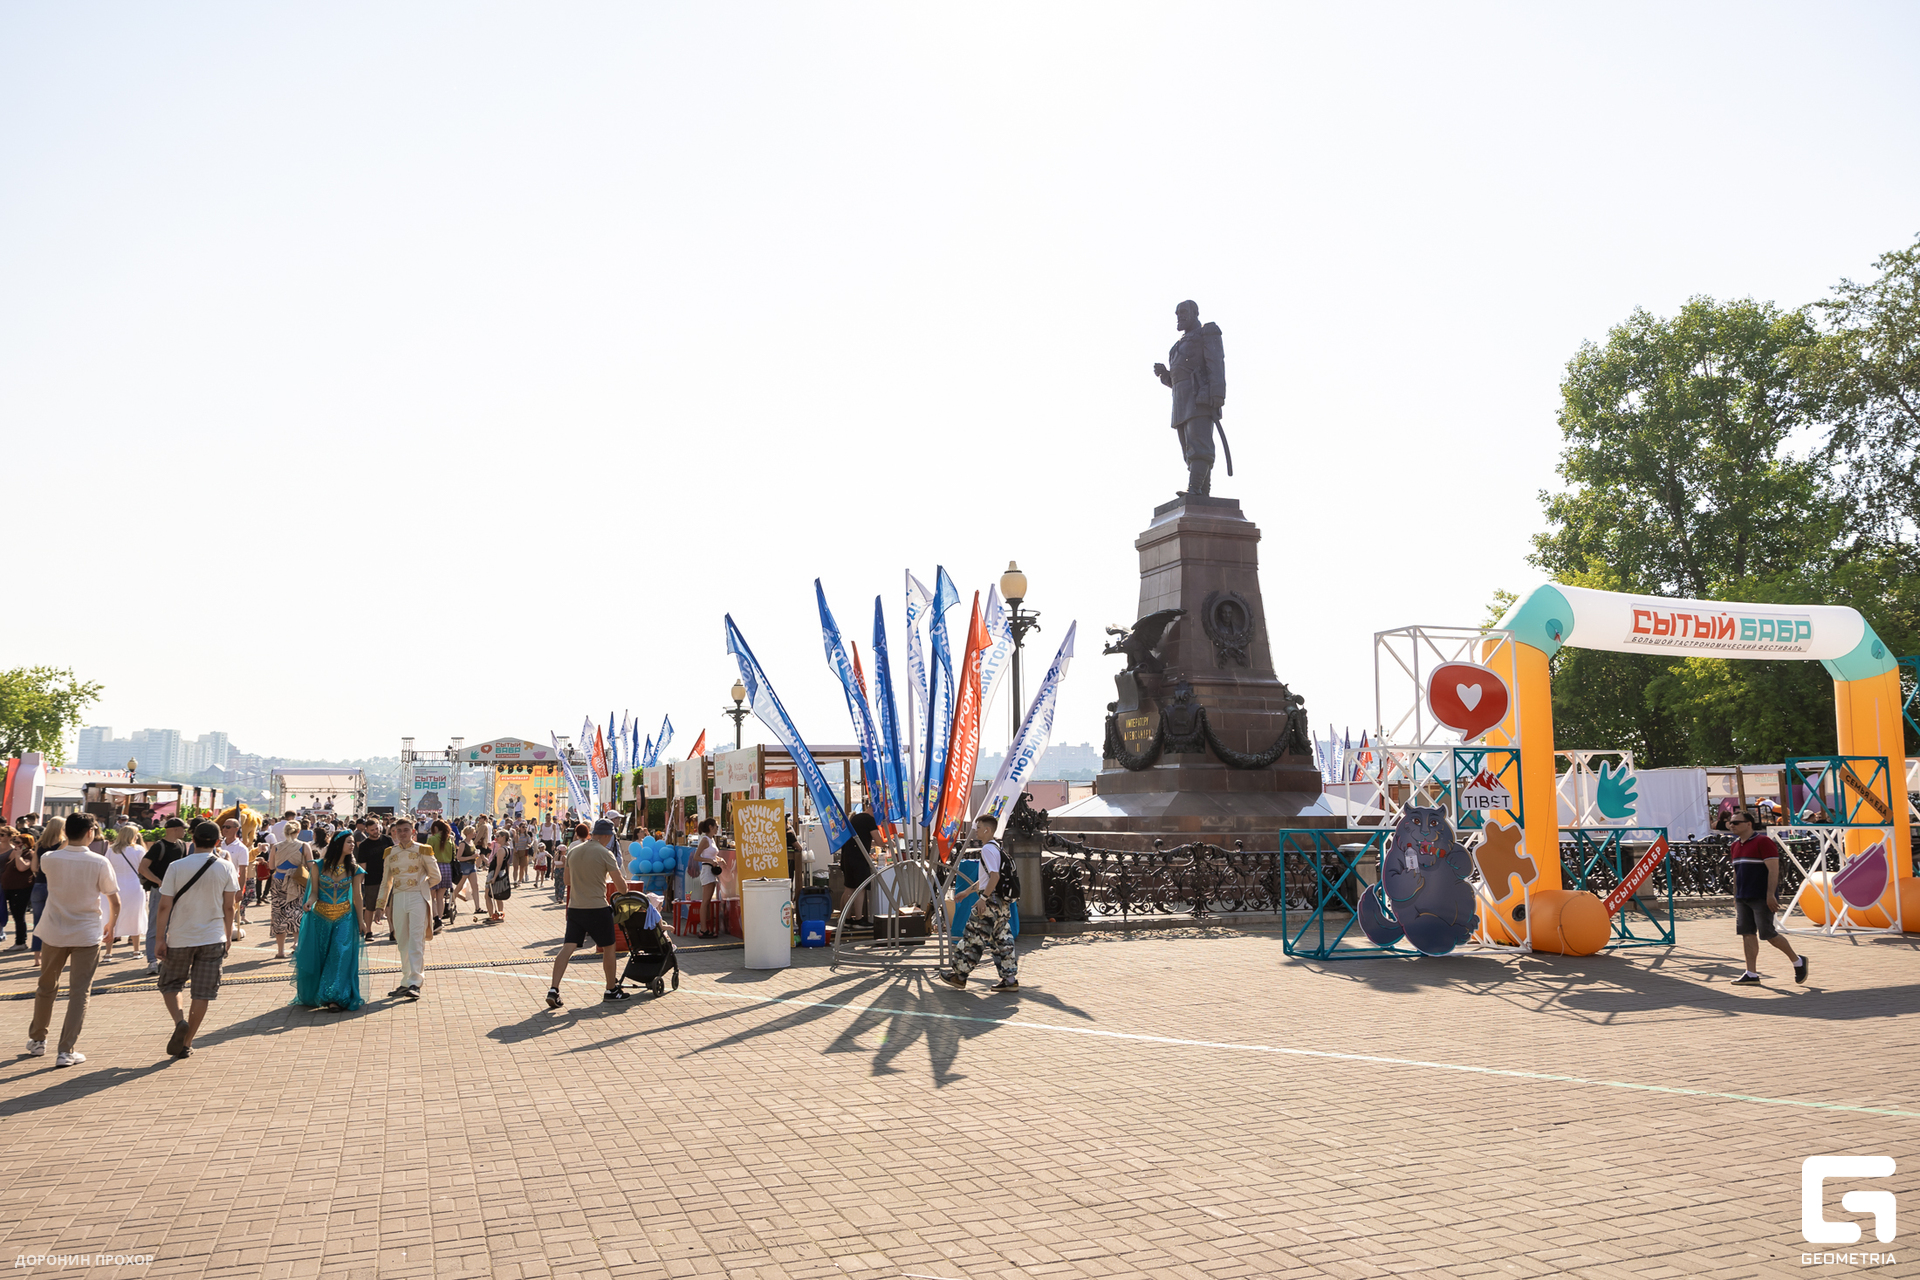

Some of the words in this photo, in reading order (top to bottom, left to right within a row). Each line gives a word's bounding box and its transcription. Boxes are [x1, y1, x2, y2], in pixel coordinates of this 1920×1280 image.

[1632, 609, 1736, 641] СЫТЫЙ
[1738, 617, 1812, 643] БАБР
[1631, 636, 1674, 645] БОЛЬШОЙ
[1673, 639, 1758, 650] ГАСТРОНОМИЧЕСКИЙ
[1757, 644, 1803, 652] ФЕСТИВАЛЬ
[935, 704, 949, 749] ДНЁМ
[933, 750, 944, 764] С
[414, 774, 447, 782] СЫТЫЙ
[414, 781, 446, 789] БАБР
[1464, 795, 1510, 809] TIBET
[1845, 774, 1870, 800] СЕМЬЯ
[1874, 800, 1888, 817] ЕДА
[1608, 845, 1662, 911] #СЫТЫЙБАБР
